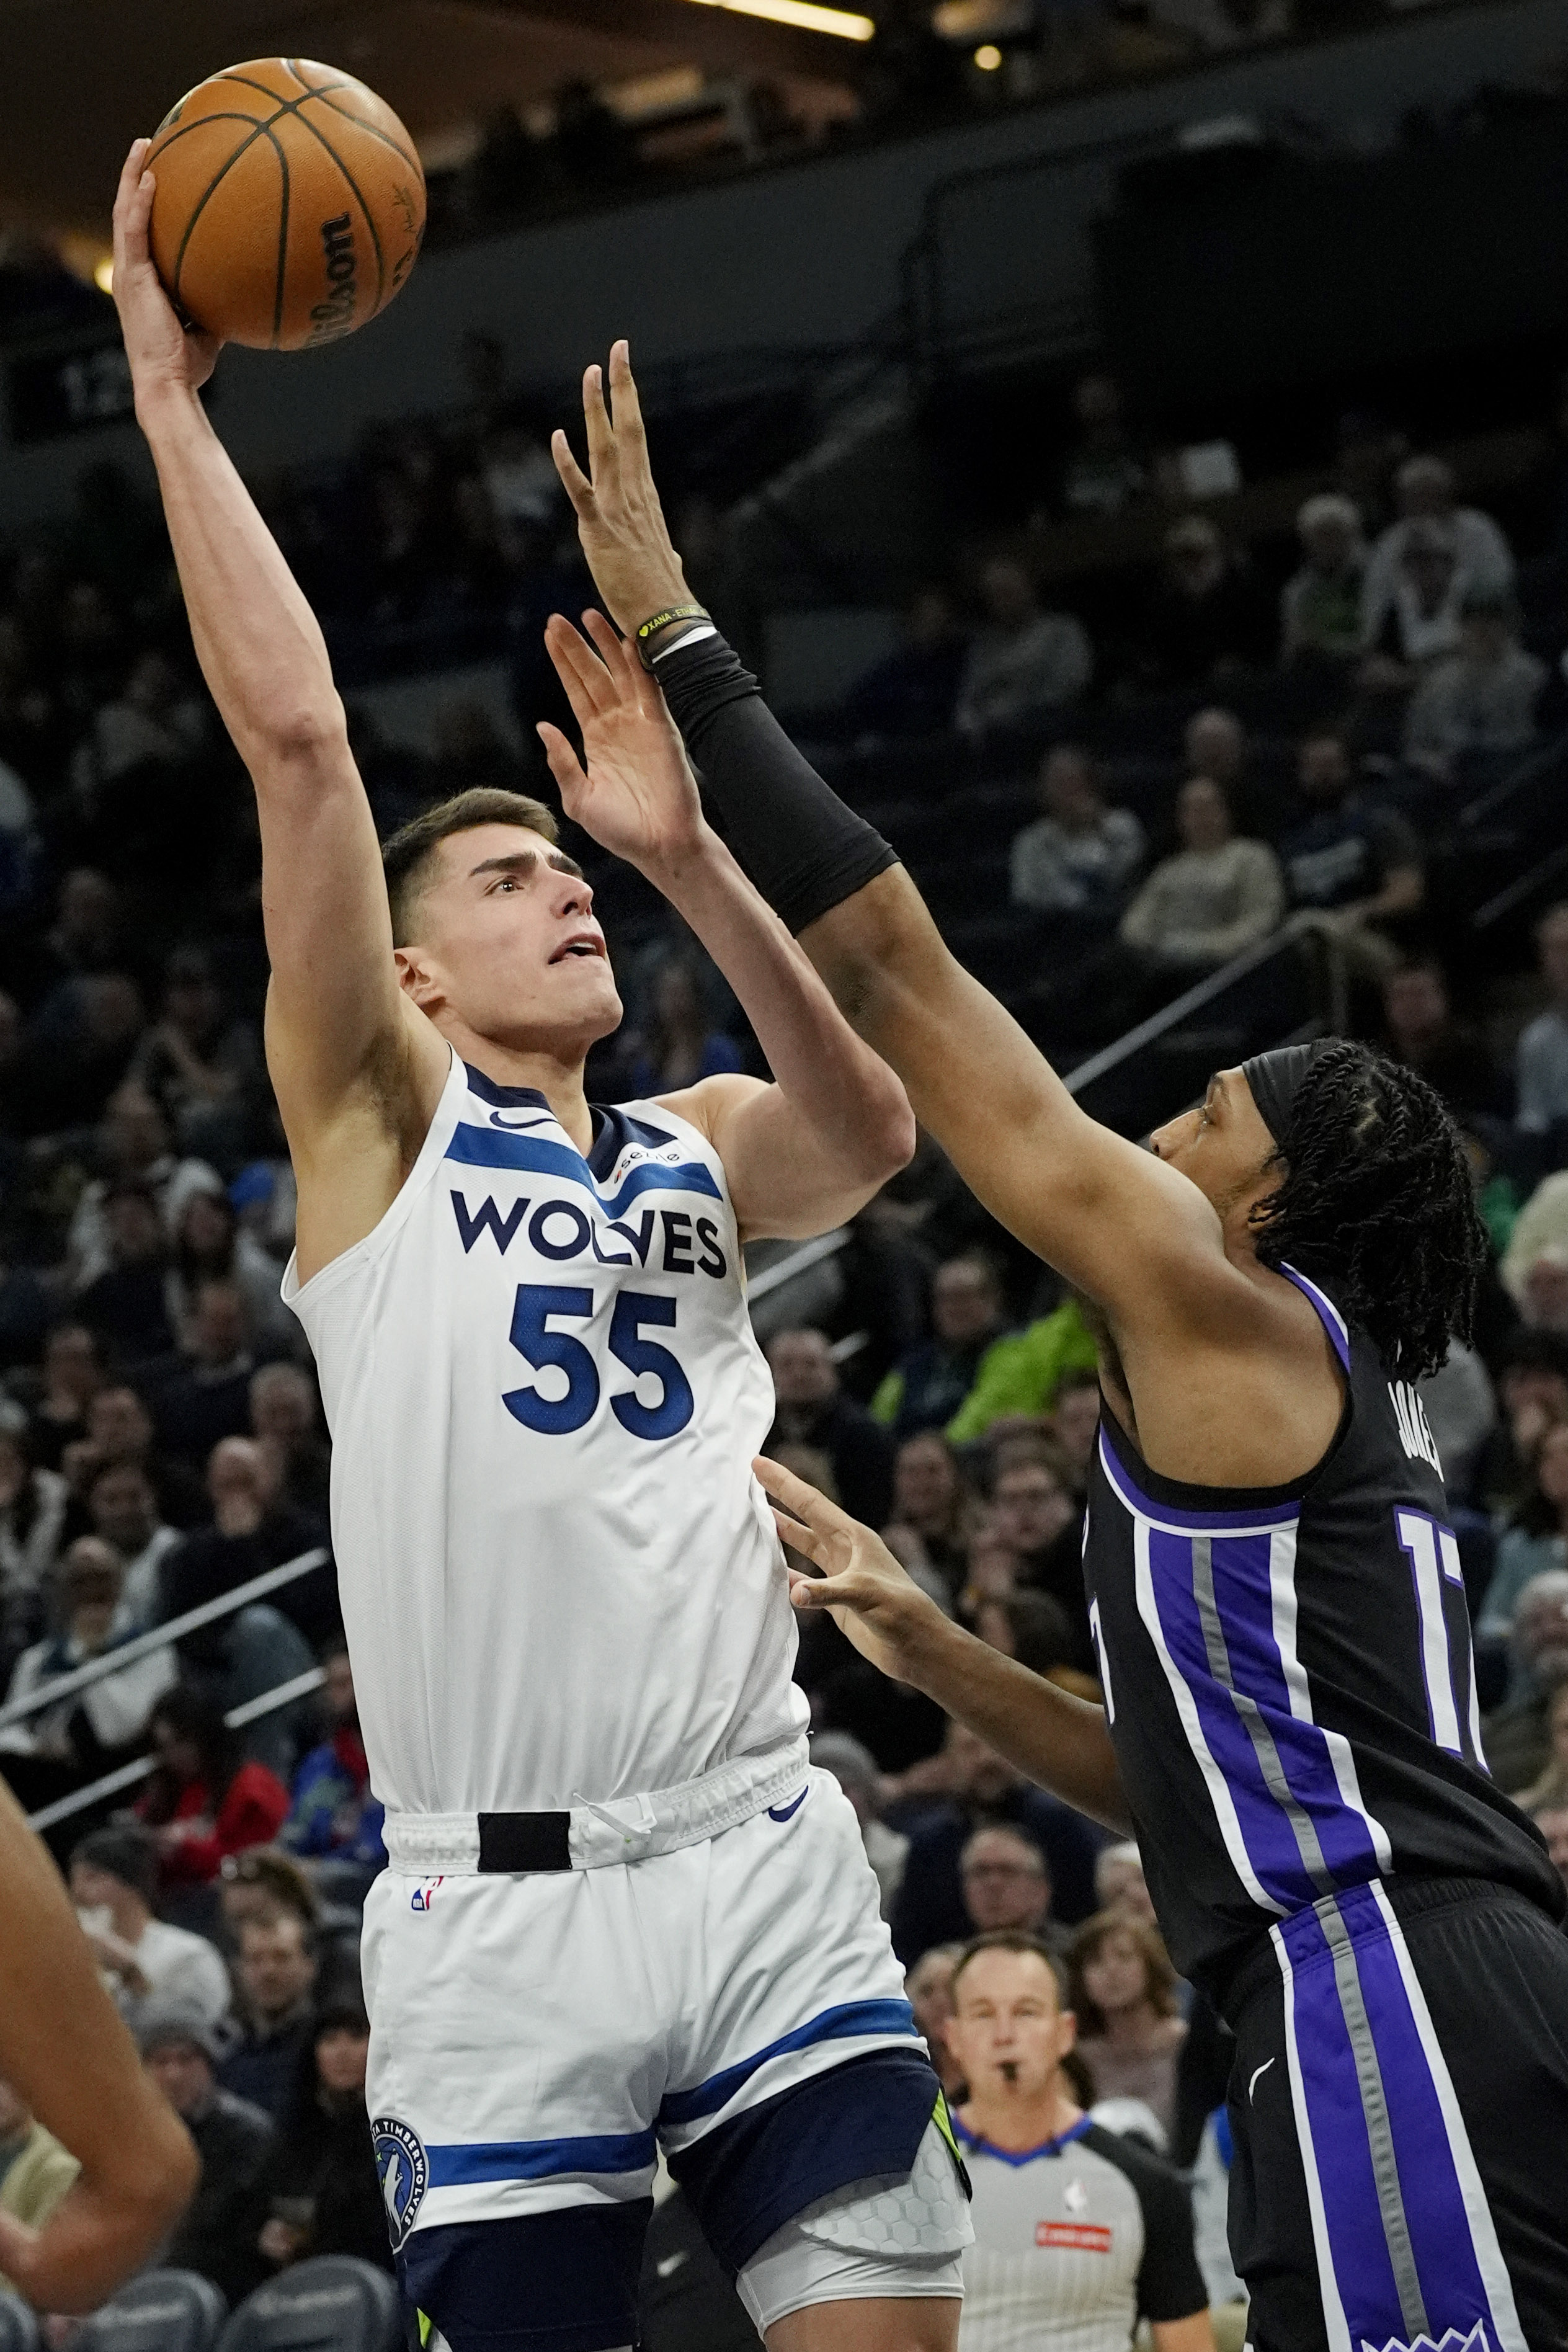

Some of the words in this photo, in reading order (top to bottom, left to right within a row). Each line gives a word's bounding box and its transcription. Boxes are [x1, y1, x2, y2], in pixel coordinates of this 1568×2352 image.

[648, 612, 672, 631] XANA
[450, 1190, 727, 1279] WOLVES
[501, 1283, 694, 1441] 55
[383, 2121, 424, 2226] TIMBERWOLVES
